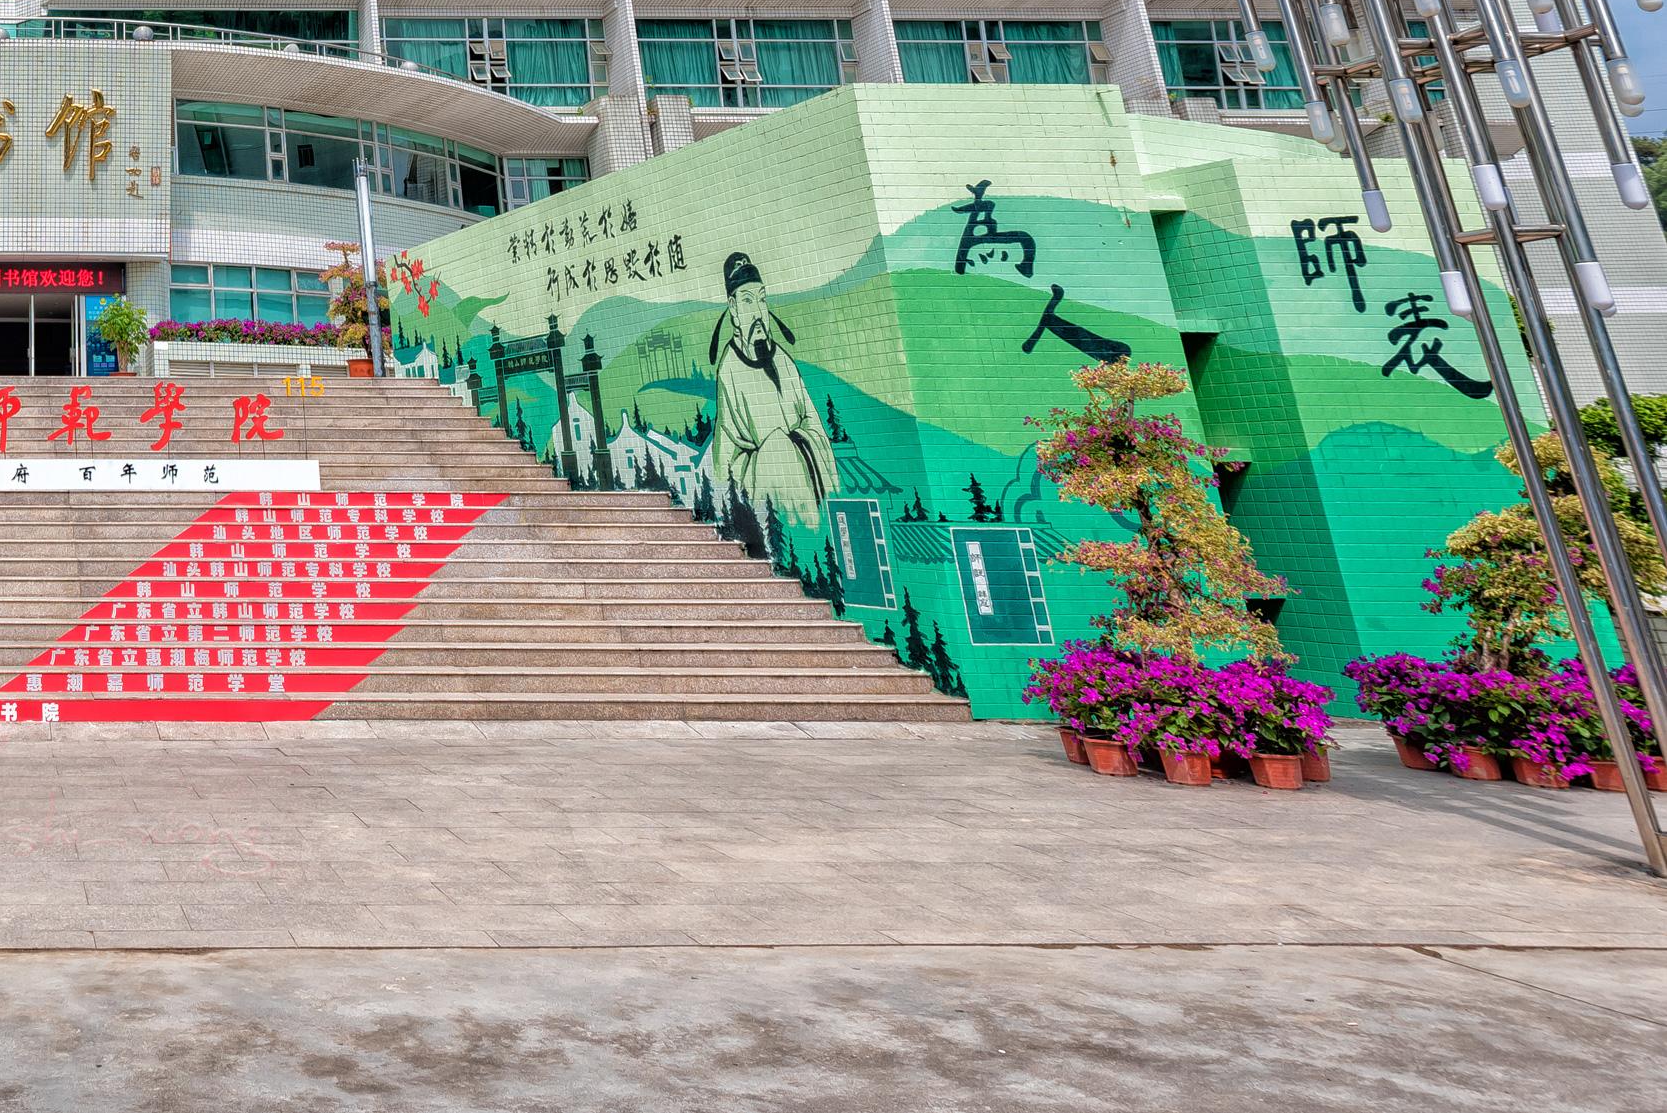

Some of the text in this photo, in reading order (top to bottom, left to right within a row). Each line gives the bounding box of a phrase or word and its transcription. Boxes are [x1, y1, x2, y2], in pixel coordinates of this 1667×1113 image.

[282, 376, 326, 398] 115
[79, 463, 219, 485] 百年师范
[260, 493, 463, 506] 韩山师范学院
[236, 509, 443, 522] 韩山师范专科学校
[214, 526, 427, 539] 汕头地区师范学校
[190, 544, 410, 557] 韩山师范学校
[164, 562, 390, 577] 汕头韩山师范专科学校
[137, 582, 370, 598] 韩山师范学校
[112, 603, 354, 619] 广东省立韩山师范学校
[85, 625, 332, 641] 广东省立第二师范学校
[50, 649, 305, 666] 广东省立惠潮梅师范学校
[27, 674, 284, 691] 惠潮嘉师范学堂
